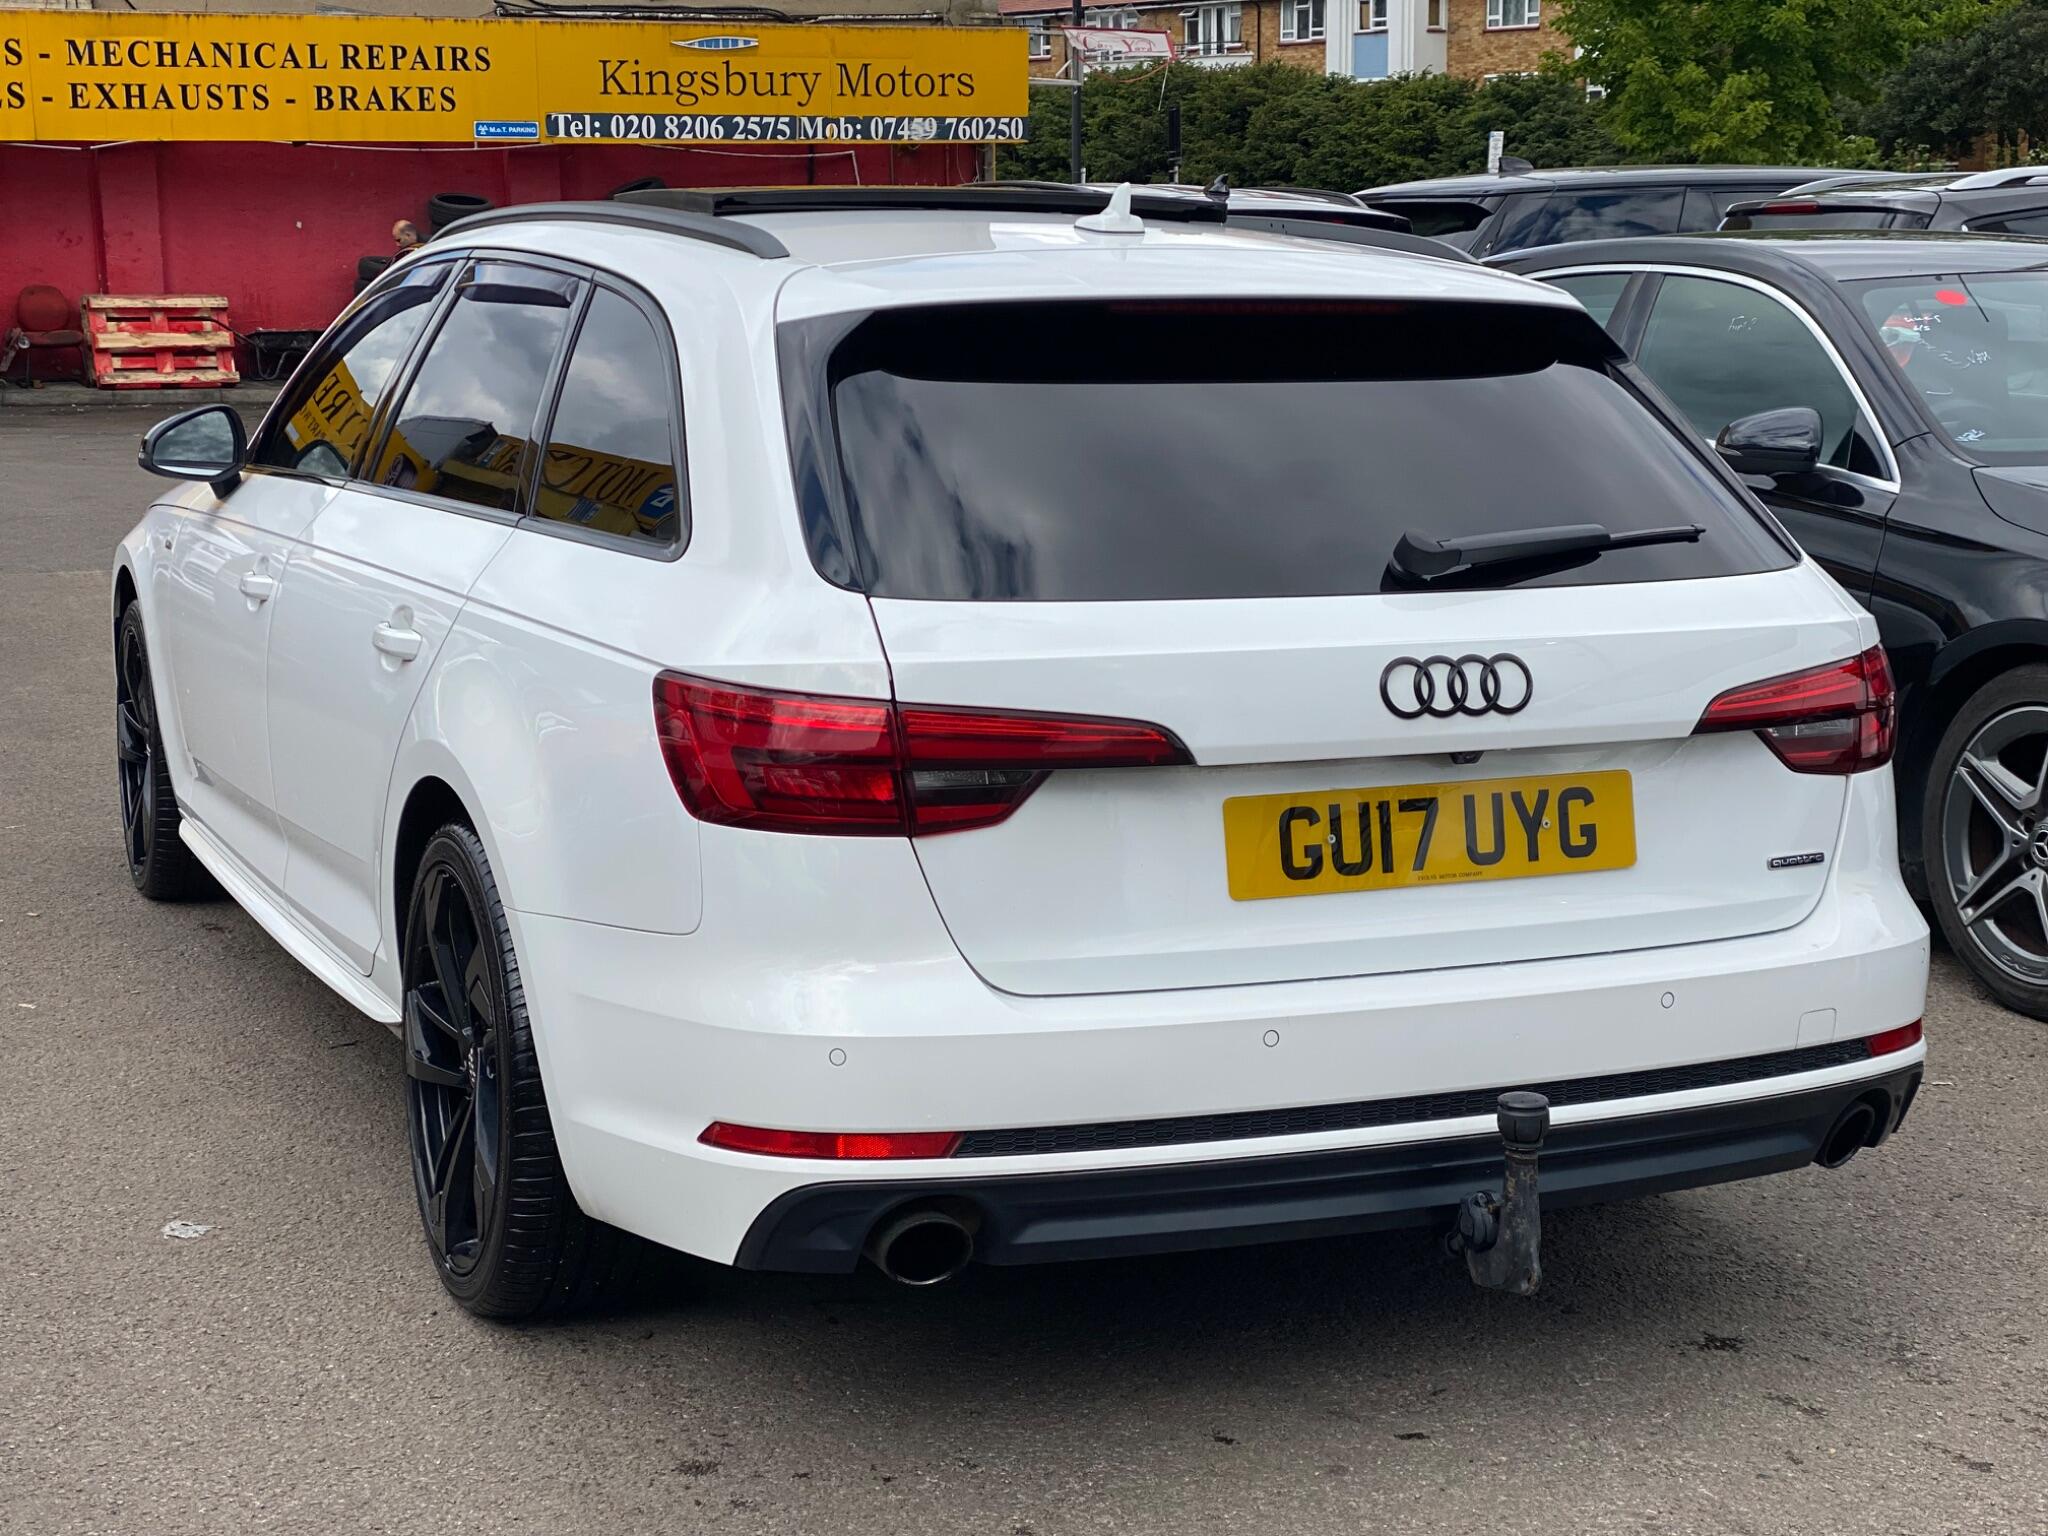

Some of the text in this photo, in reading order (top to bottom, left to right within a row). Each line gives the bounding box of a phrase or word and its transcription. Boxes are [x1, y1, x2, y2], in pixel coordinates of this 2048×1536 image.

[65, 39, 328, 70] MECHANICAL
[340, 43, 492, 72] REPAIRS
[0, 81, 26, 109] S
[68, 82, 270, 111] EXHAUSTS
[314, 85, 456, 112] BRAKES
[598, 59, 975, 107] Kingsbury Motors
[508, 126, 537, 134] PARKING
[551, 114, 601, 138] Tel:
[610, 114, 656, 139] 020
[664, 115, 724, 140] 8206
[732, 116, 790, 140] 2575
[800, 117, 862, 140] Mob:
[945, 117, 1023, 140] 760250
[1279, 787, 1597, 881] GU17 UYG
[1772, 853, 1823, 868] quattro
